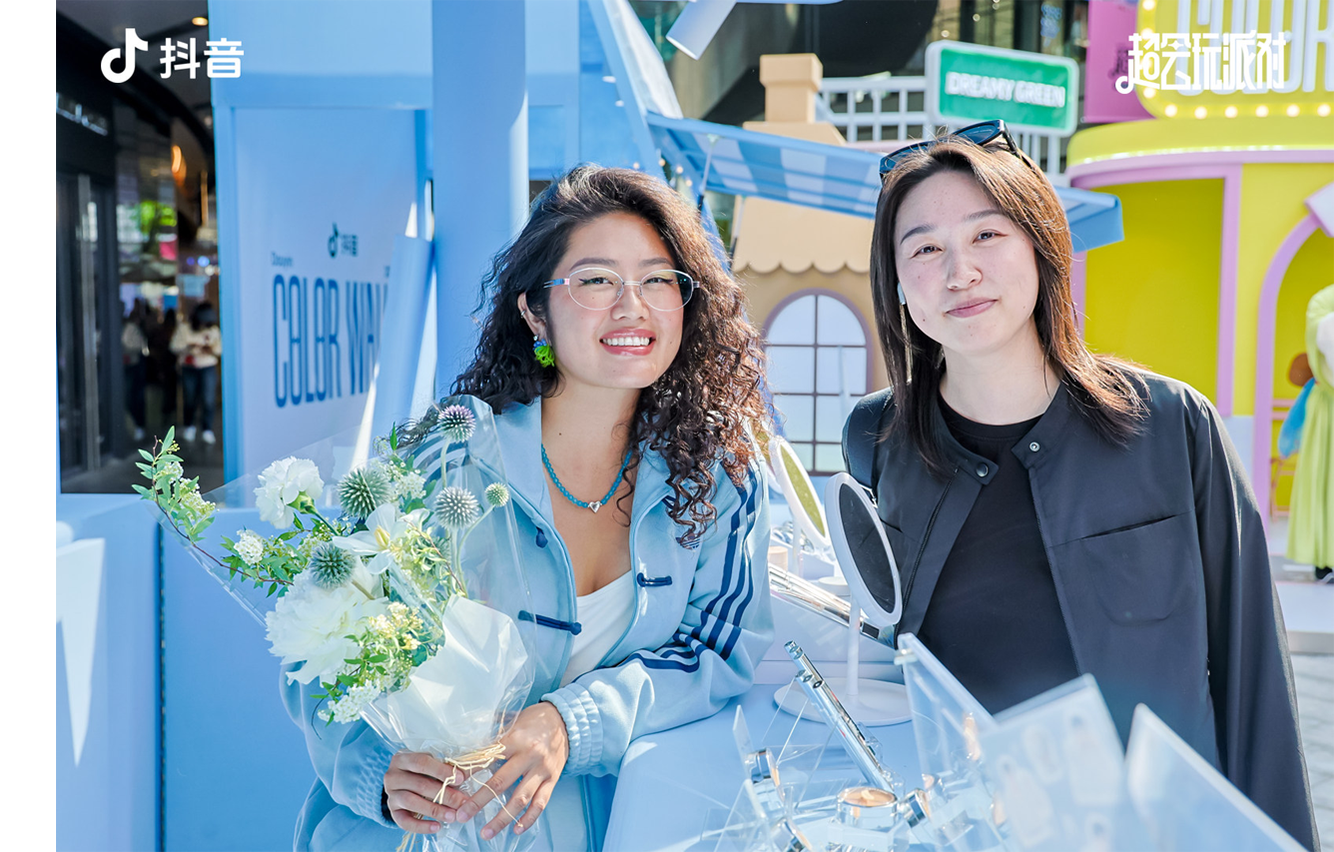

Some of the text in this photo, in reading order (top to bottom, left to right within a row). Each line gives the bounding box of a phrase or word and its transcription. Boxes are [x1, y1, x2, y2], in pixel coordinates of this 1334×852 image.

[945, 71, 1066, 108] DREAMY GREEN
[273, 274, 343, 409] COLOR
